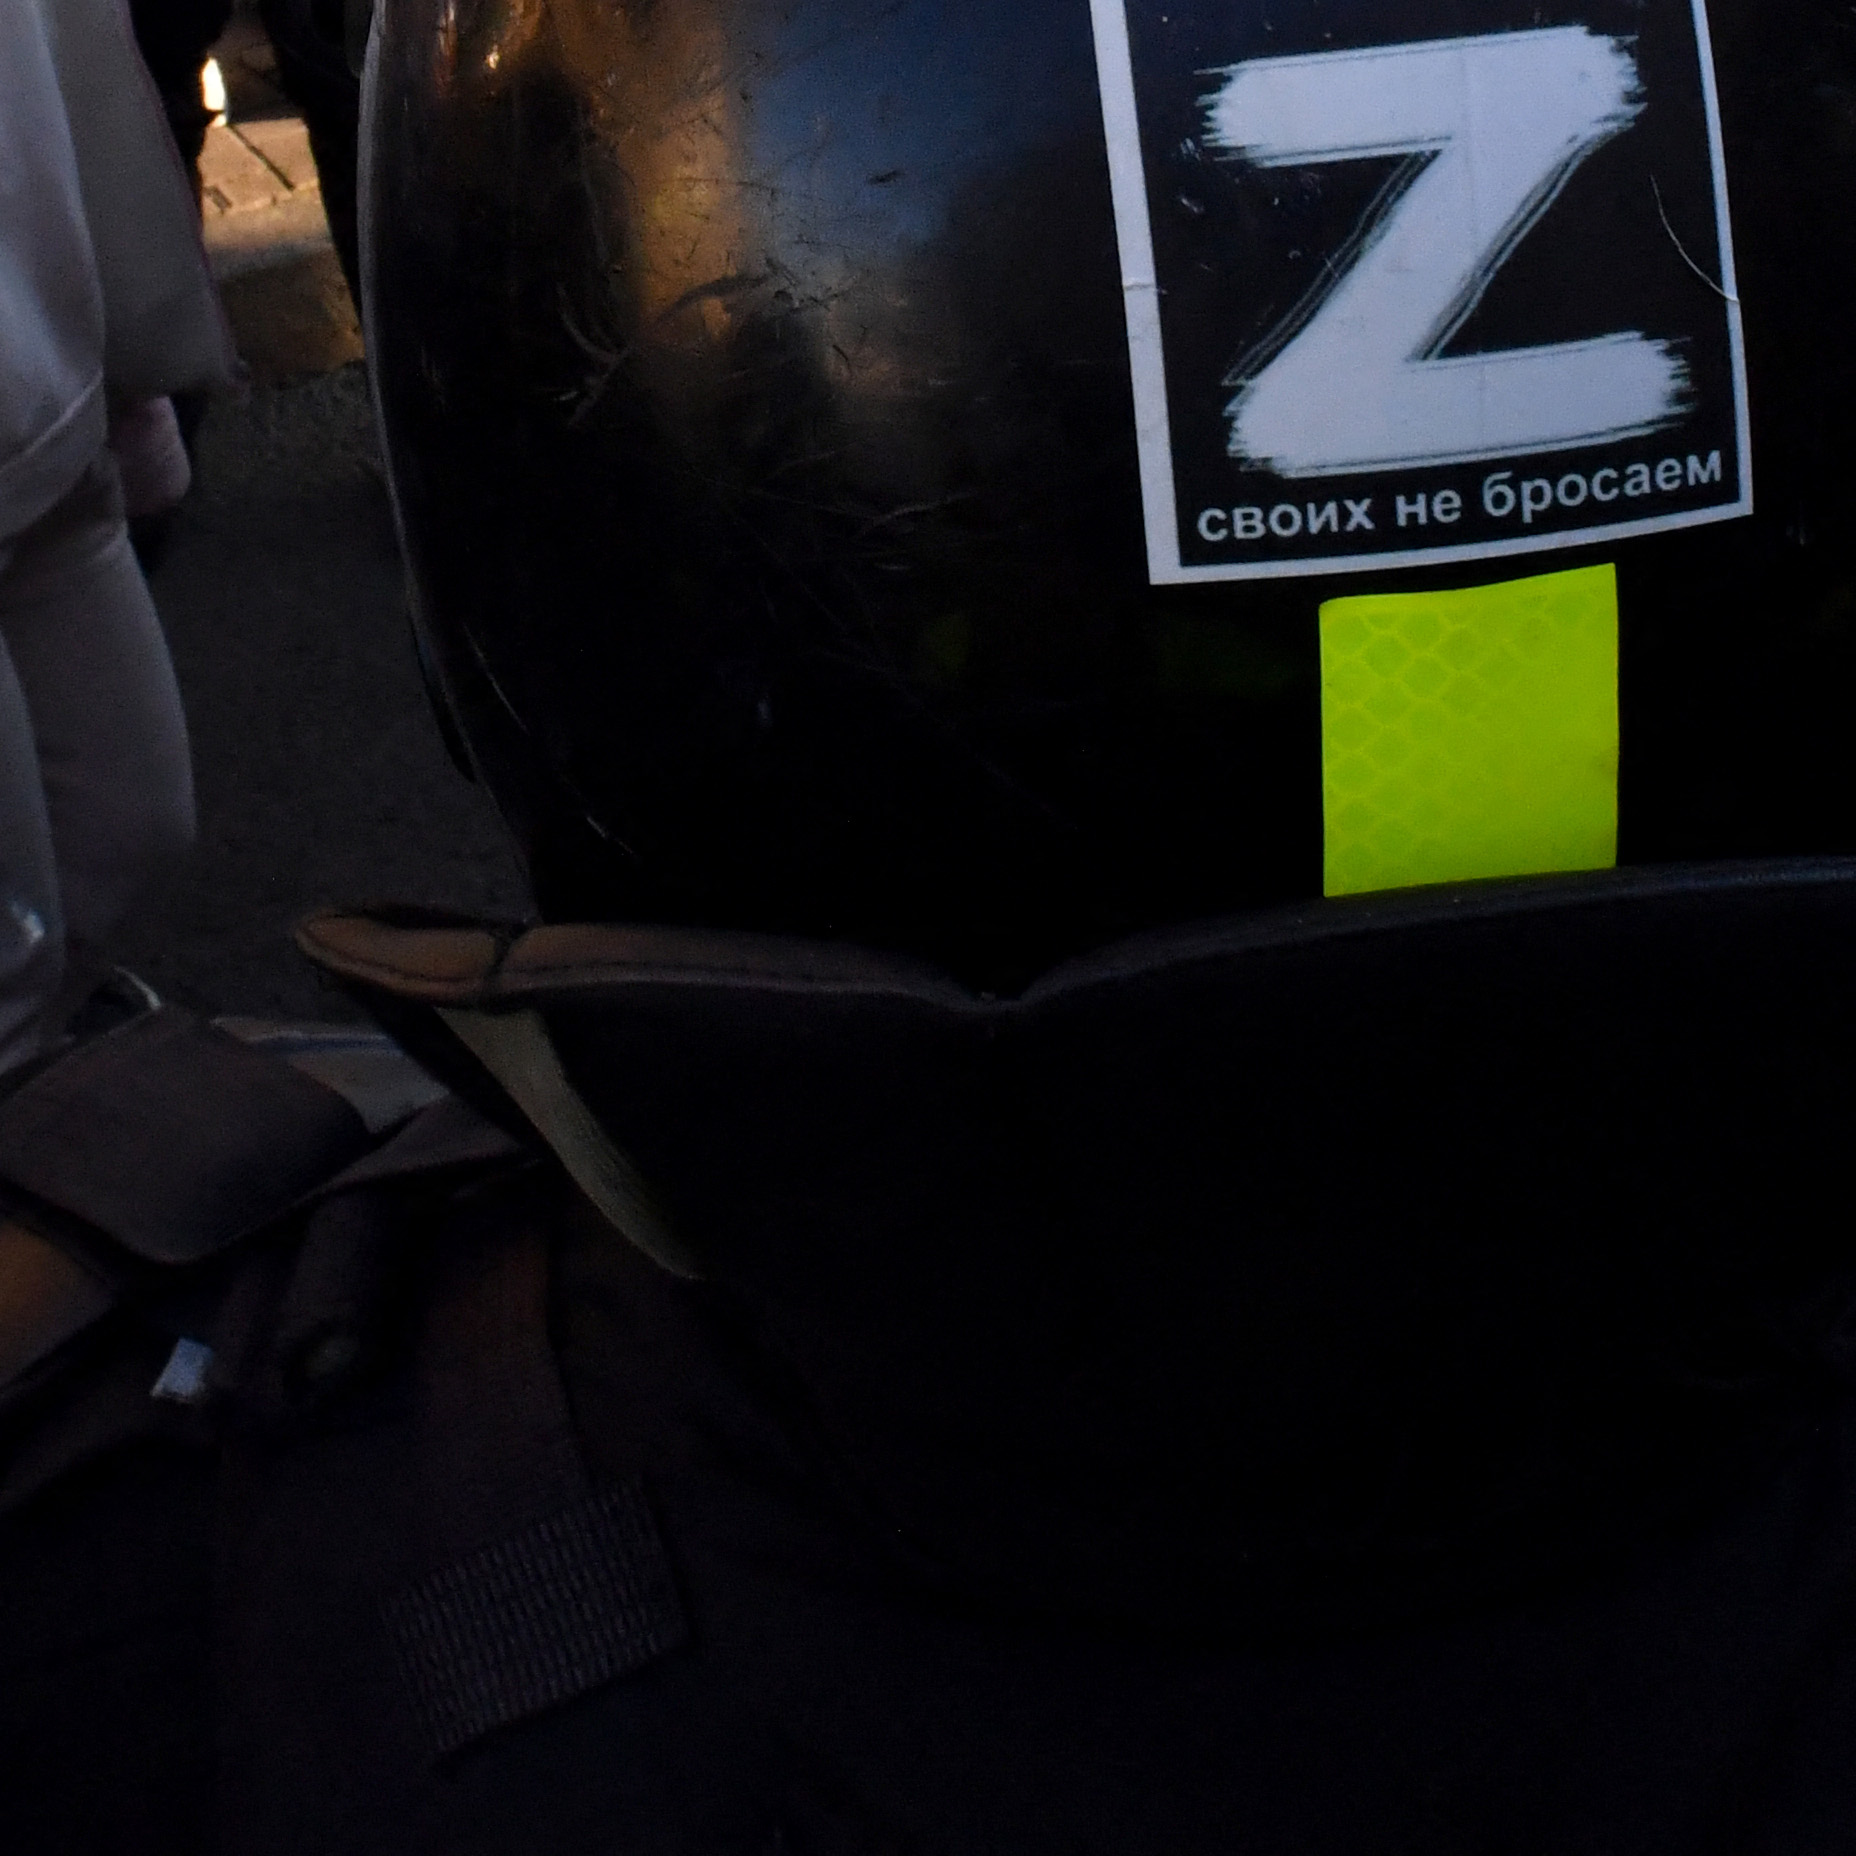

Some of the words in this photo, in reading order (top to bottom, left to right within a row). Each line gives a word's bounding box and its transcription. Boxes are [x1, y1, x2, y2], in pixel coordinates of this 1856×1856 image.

[1194, 24, 1693, 479] Z
[1197, 497, 1375, 541] своих
[1395, 488, 1463, 527] не
[1482, 449, 1724, 523] бросаем
